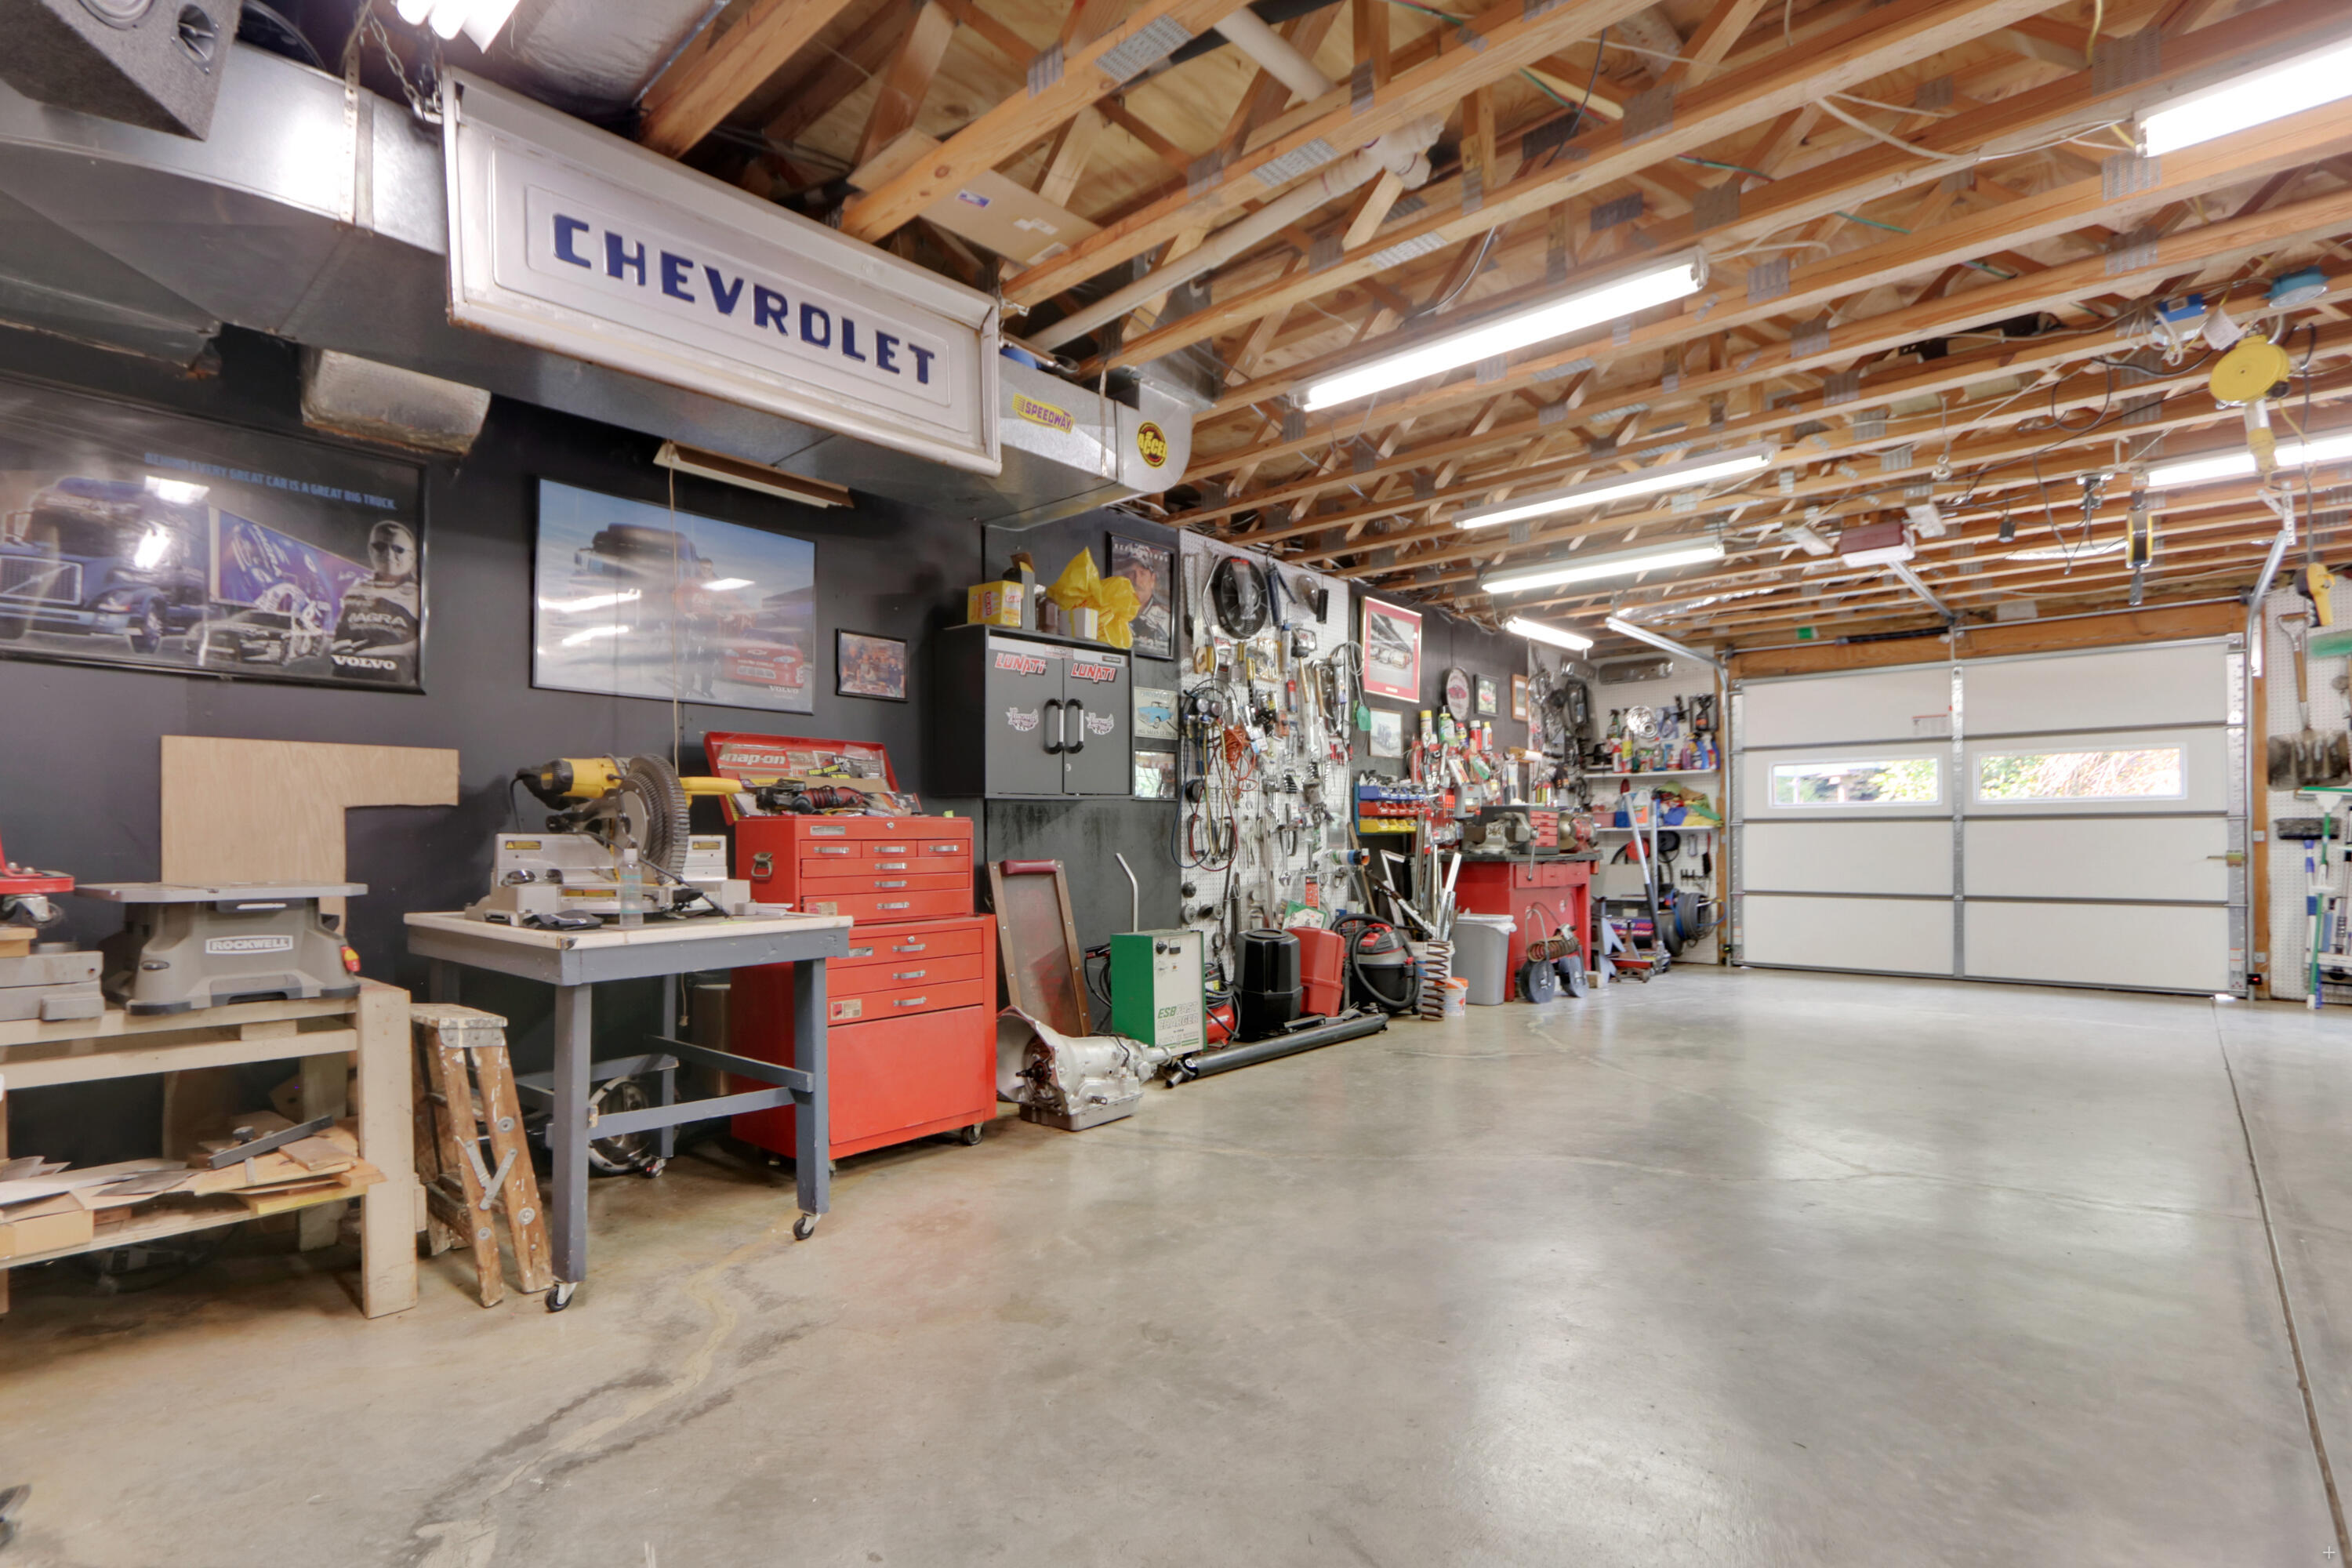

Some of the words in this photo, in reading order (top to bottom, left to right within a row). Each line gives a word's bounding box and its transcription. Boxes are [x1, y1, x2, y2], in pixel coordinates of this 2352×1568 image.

[552, 212, 935, 385] CHEVROLET
[1025, 401, 1073, 431] SPEEDWAY
[229, 467, 265, 485] GREAT
[266, 475, 288, 490] CAR
[289, 480, 300, 492] IS
[301, 482, 310, 494] A
[310, 484, 343, 499] GREAT
[344, 490, 362, 504] BIG
[331, 654, 397, 670] VOLVO
[995, 653, 1047, 676] LUNATI
[1071, 663, 1116, 684] LUNATI
[768, 685, 799, 695] VOLVO
[212, 938, 288, 950] ROCKWELL
[1158, 1006, 1177, 1018] ESB
